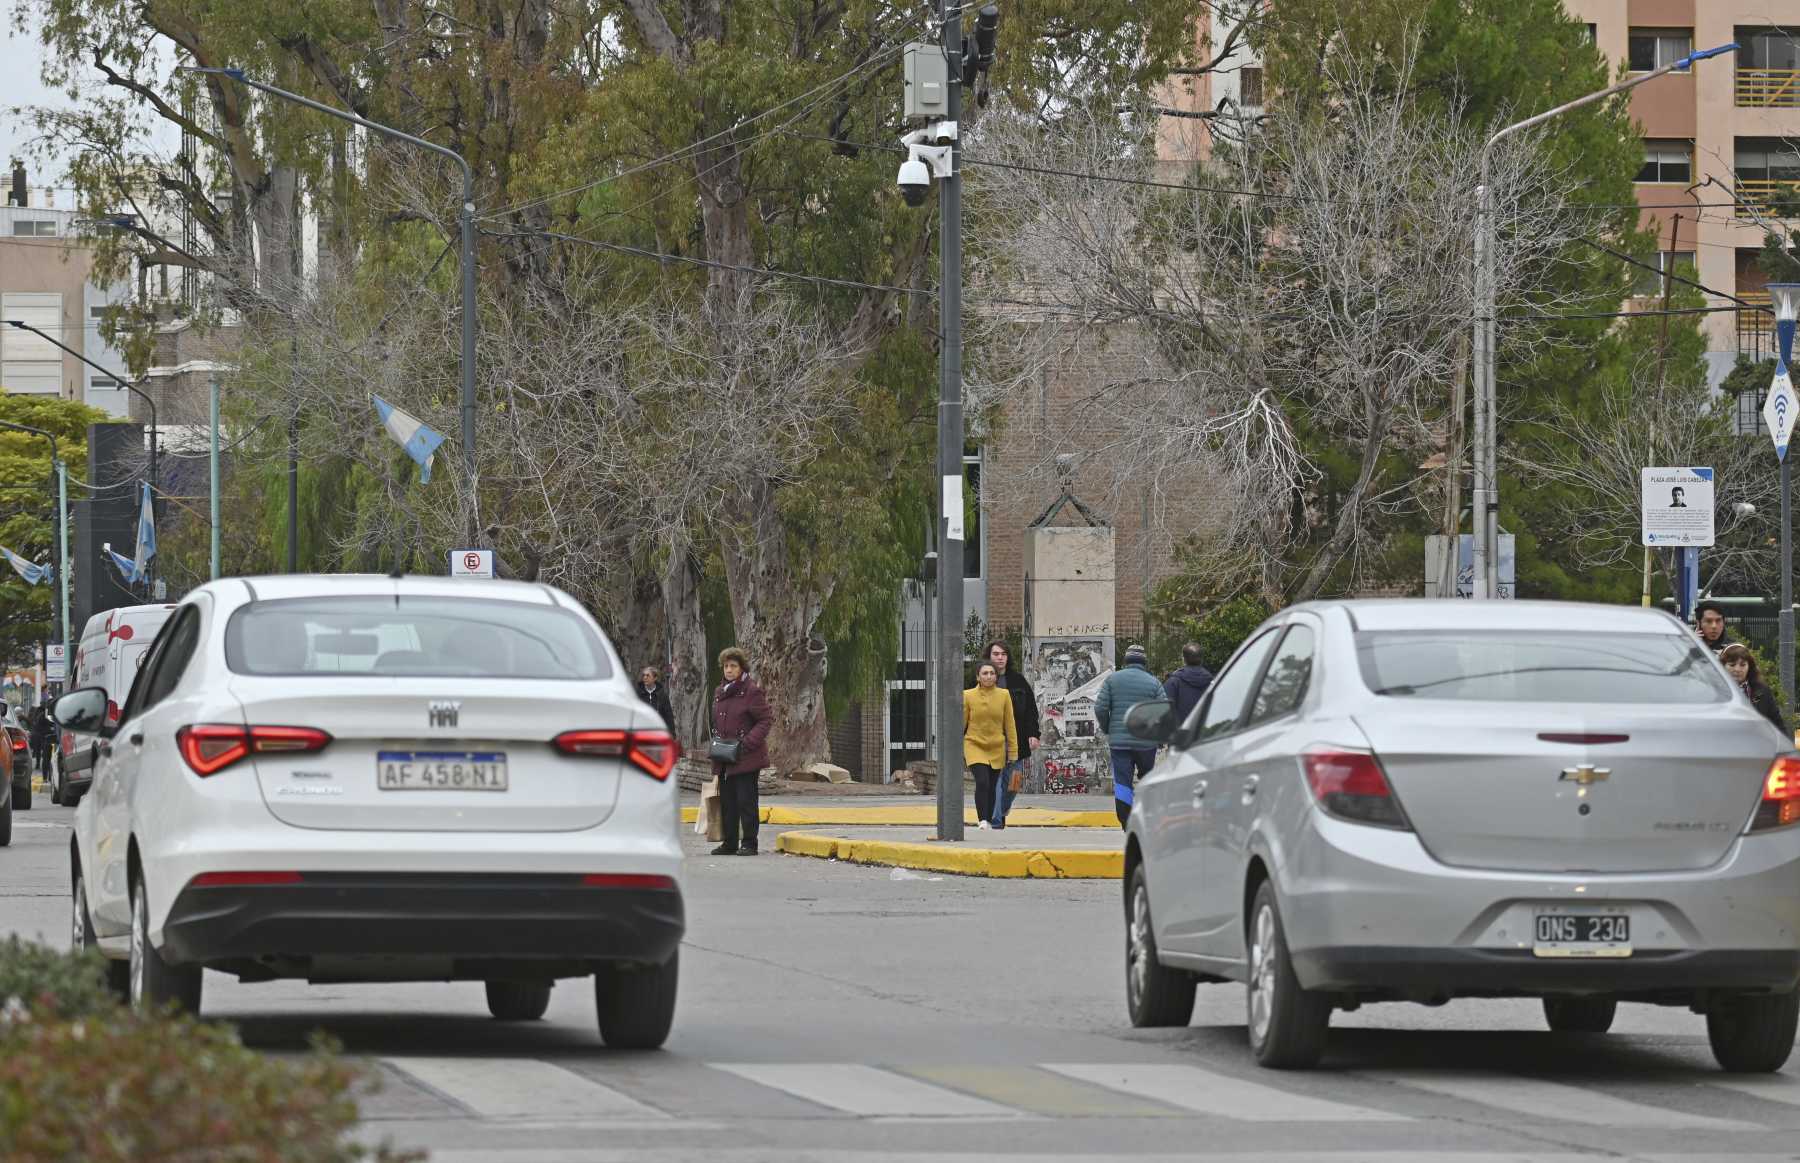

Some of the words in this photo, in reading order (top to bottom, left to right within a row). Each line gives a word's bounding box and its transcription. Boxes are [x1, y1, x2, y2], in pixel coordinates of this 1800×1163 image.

[385, 764, 412, 785] AF
[422, 764, 464, 785] 458
[472, 764, 499, 785] NI
[1538, 917, 1577, 940] ONS
[1588, 917, 1627, 940] 234
